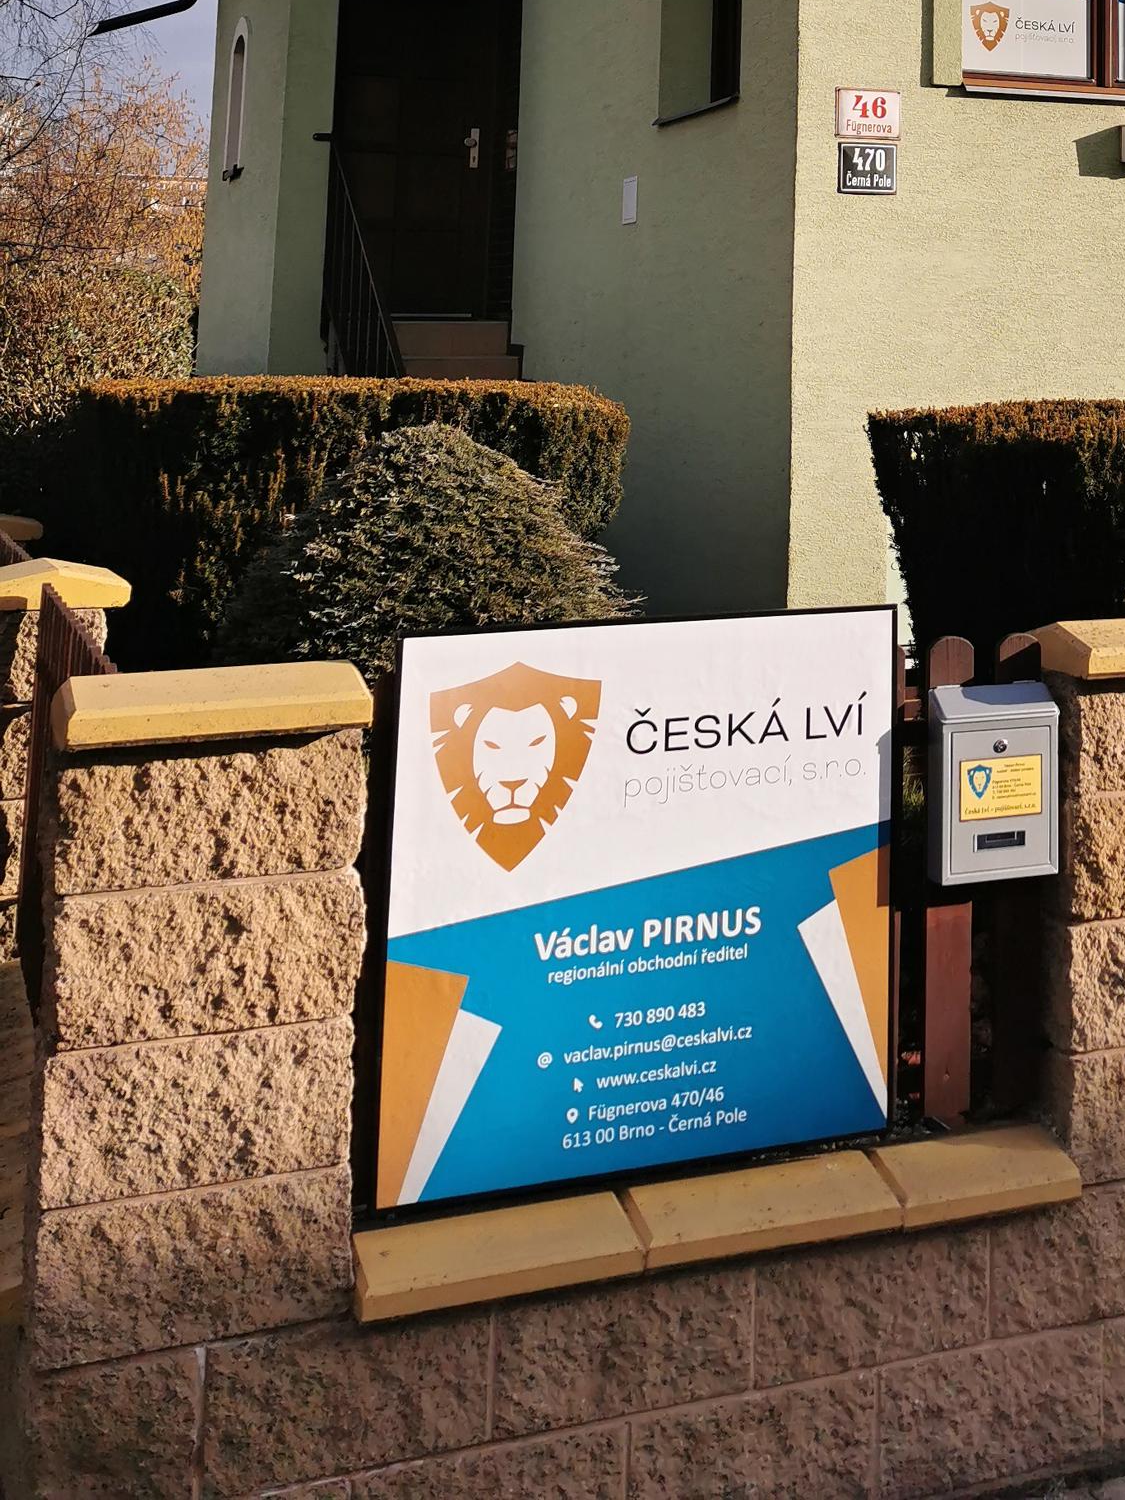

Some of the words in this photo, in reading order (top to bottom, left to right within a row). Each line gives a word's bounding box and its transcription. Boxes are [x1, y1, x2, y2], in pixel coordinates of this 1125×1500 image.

[1015, 17, 1056, 32] ČESKÁ
[1058, 21, 1076, 34] LVÍ
[852, 95, 887, 119] 46
[846, 119, 892, 134] Fügnerova
[852, 147, 886, 171] 470
[846, 170, 871, 187] Černá
[873, 173, 892, 188] Pole
[626, 697, 789, 755] ČESKÁ
[805, 690, 868, 740] LVÍ
[623, 754, 793, 809] pojišťovací,
[802, 758, 867, 781] s.r.o.
[534, 924, 634, 961] Václav
[643, 906, 762, 948] PIRNUS
[547, 959, 624, 986] regionální
[627, 949, 697, 974] obchodní
[700, 943, 748, 964] ředitel
[614, 1012, 642, 1029] 730
[646, 1005, 674, 1024] 890
[678, 1001, 706, 1019] 483
[563, 1025, 752, 1064] vaclav.pirnus@ceskalvi.cz
[596, 1059, 717, 1089] www.ceskalvi.cz
[588, 1097, 667, 1122] Fügnerova
[671, 1086, 724, 1108] 470/46
[562, 1131, 592, 1150] 613
[595, 1127, 614, 1144] 00
[619, 1123, 655, 1141] Brno
[668, 1112, 712, 1133] Černá
[716, 1107, 747, 1125] Pole
